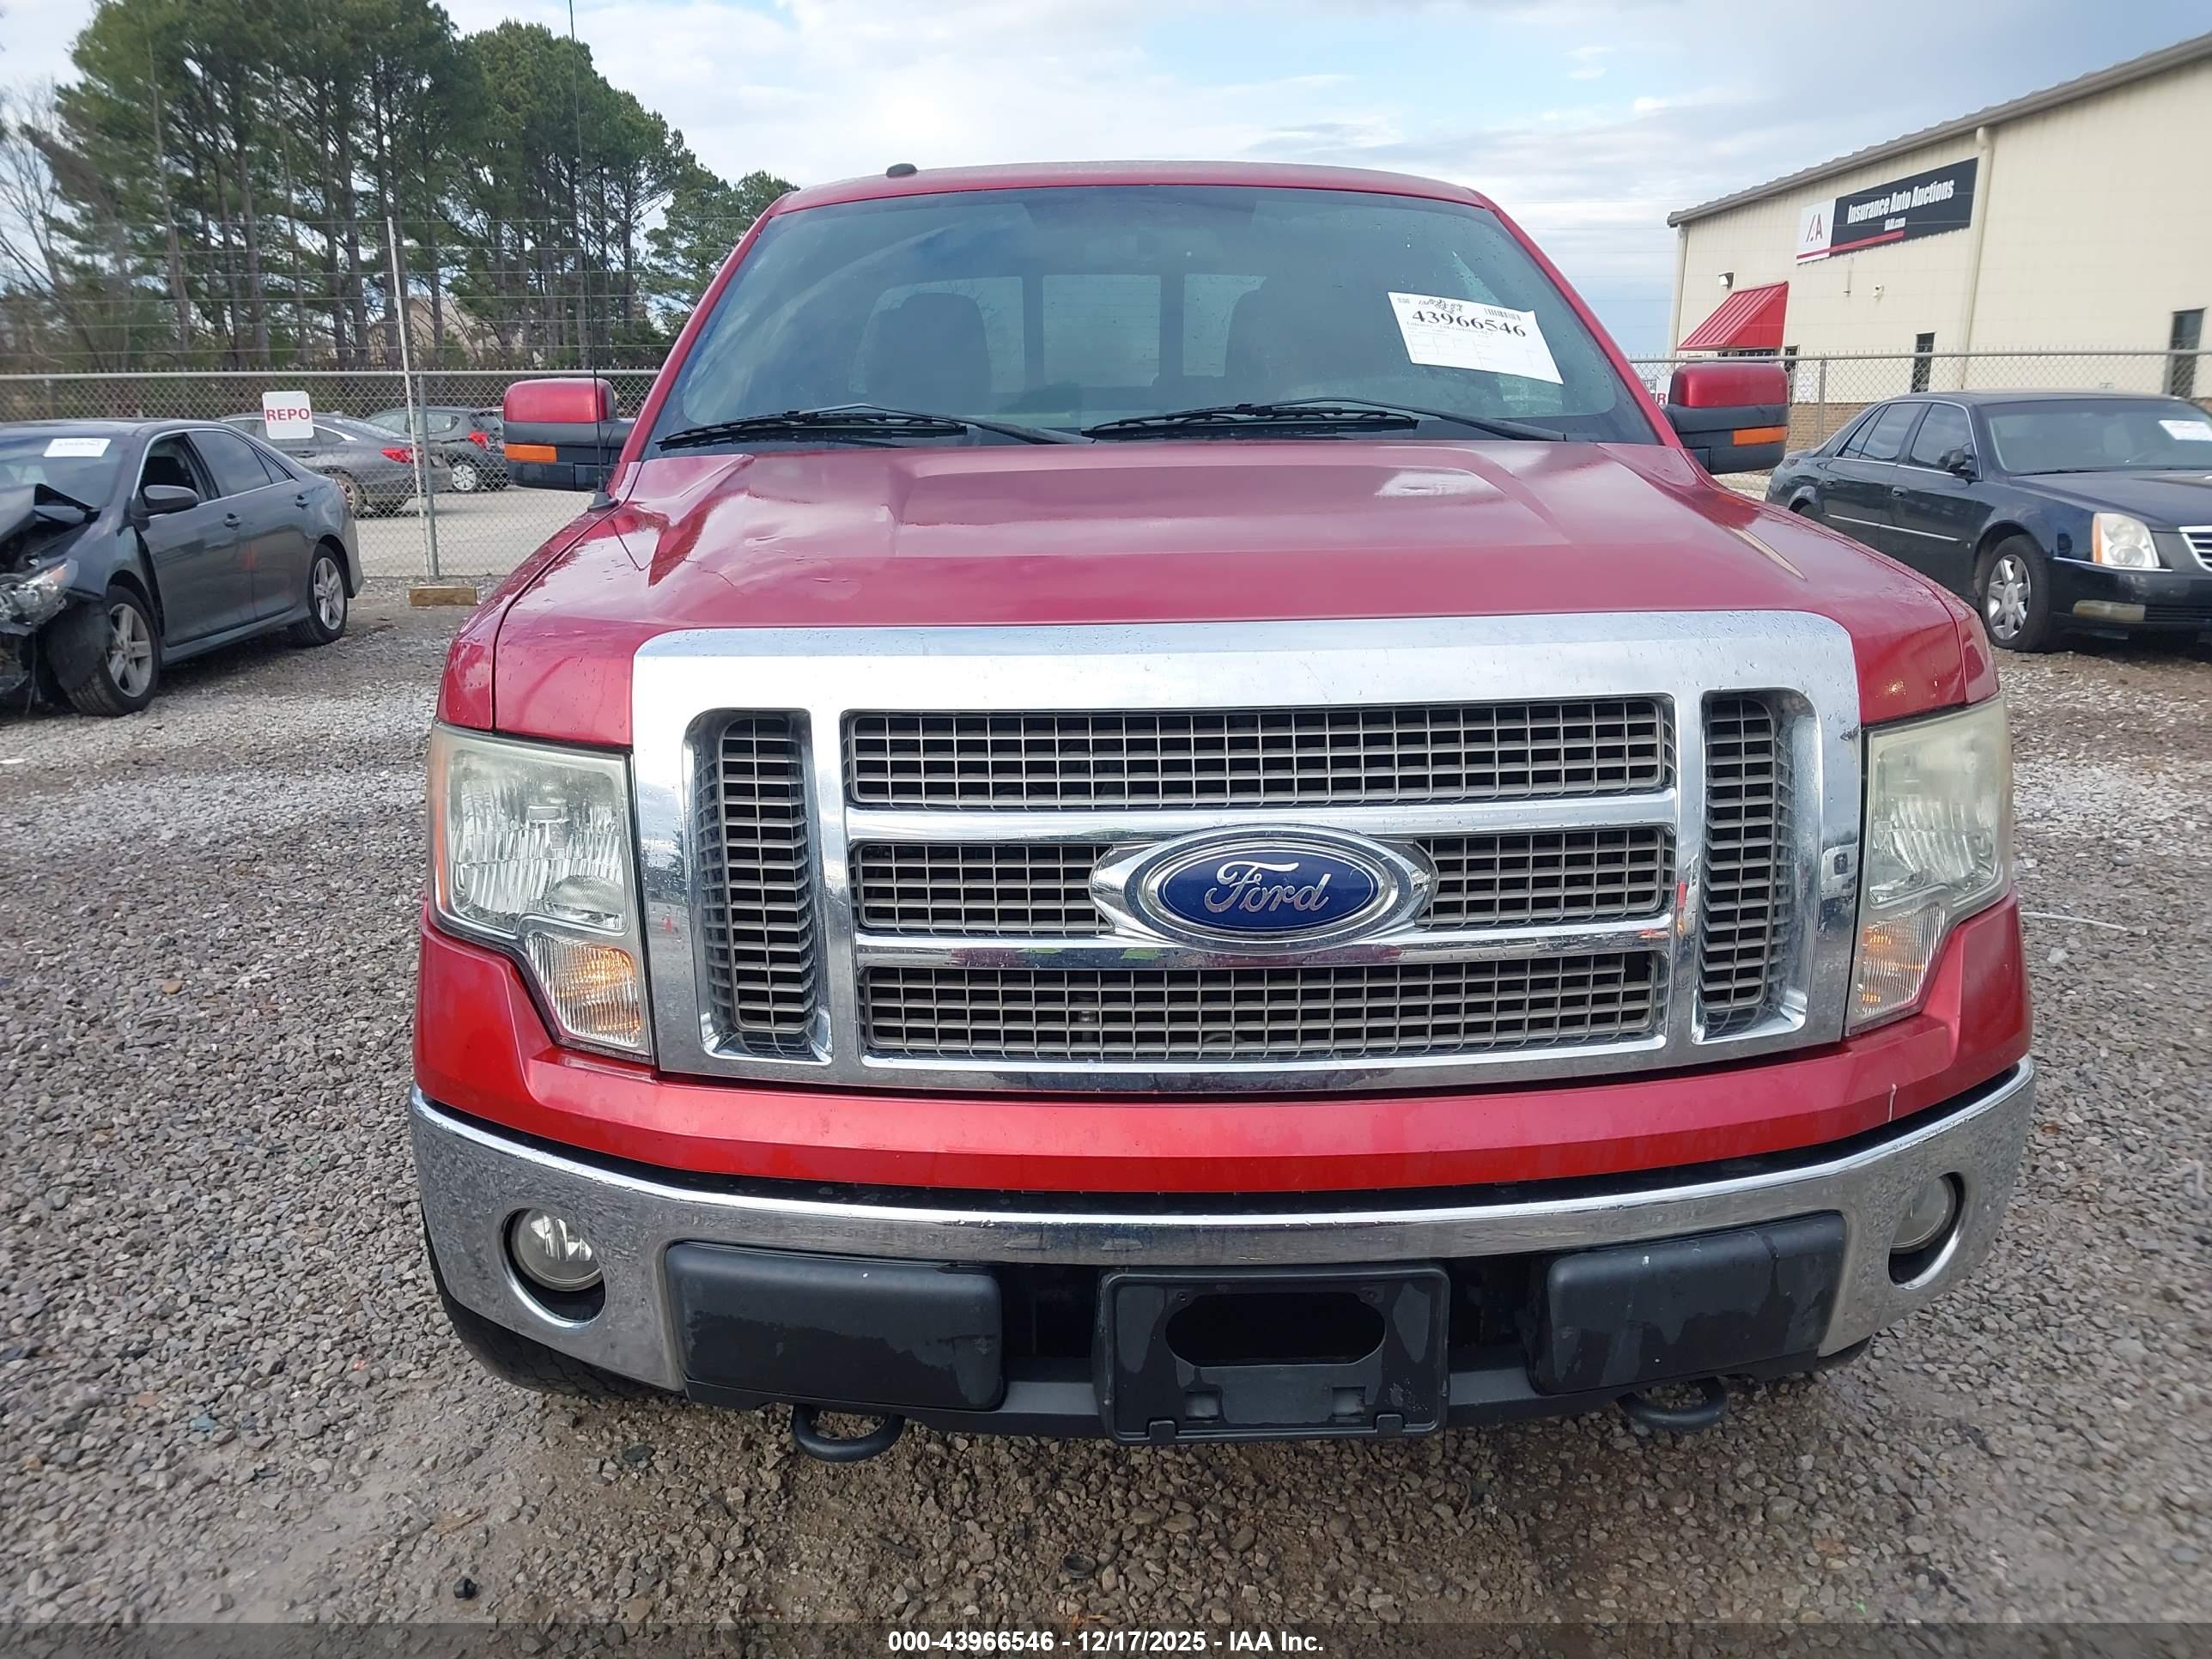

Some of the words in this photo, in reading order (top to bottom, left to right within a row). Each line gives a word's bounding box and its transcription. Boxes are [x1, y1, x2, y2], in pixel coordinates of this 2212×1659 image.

[1847, 197, 1891, 224] Insurance
[1889, 190, 1911, 214] Auto
[1911, 179, 1955, 208] Auctions
[1411, 310, 1527, 337] 43966546
[265, 408, 310, 421] REPO
[1204, 860, 1333, 913] Ford
